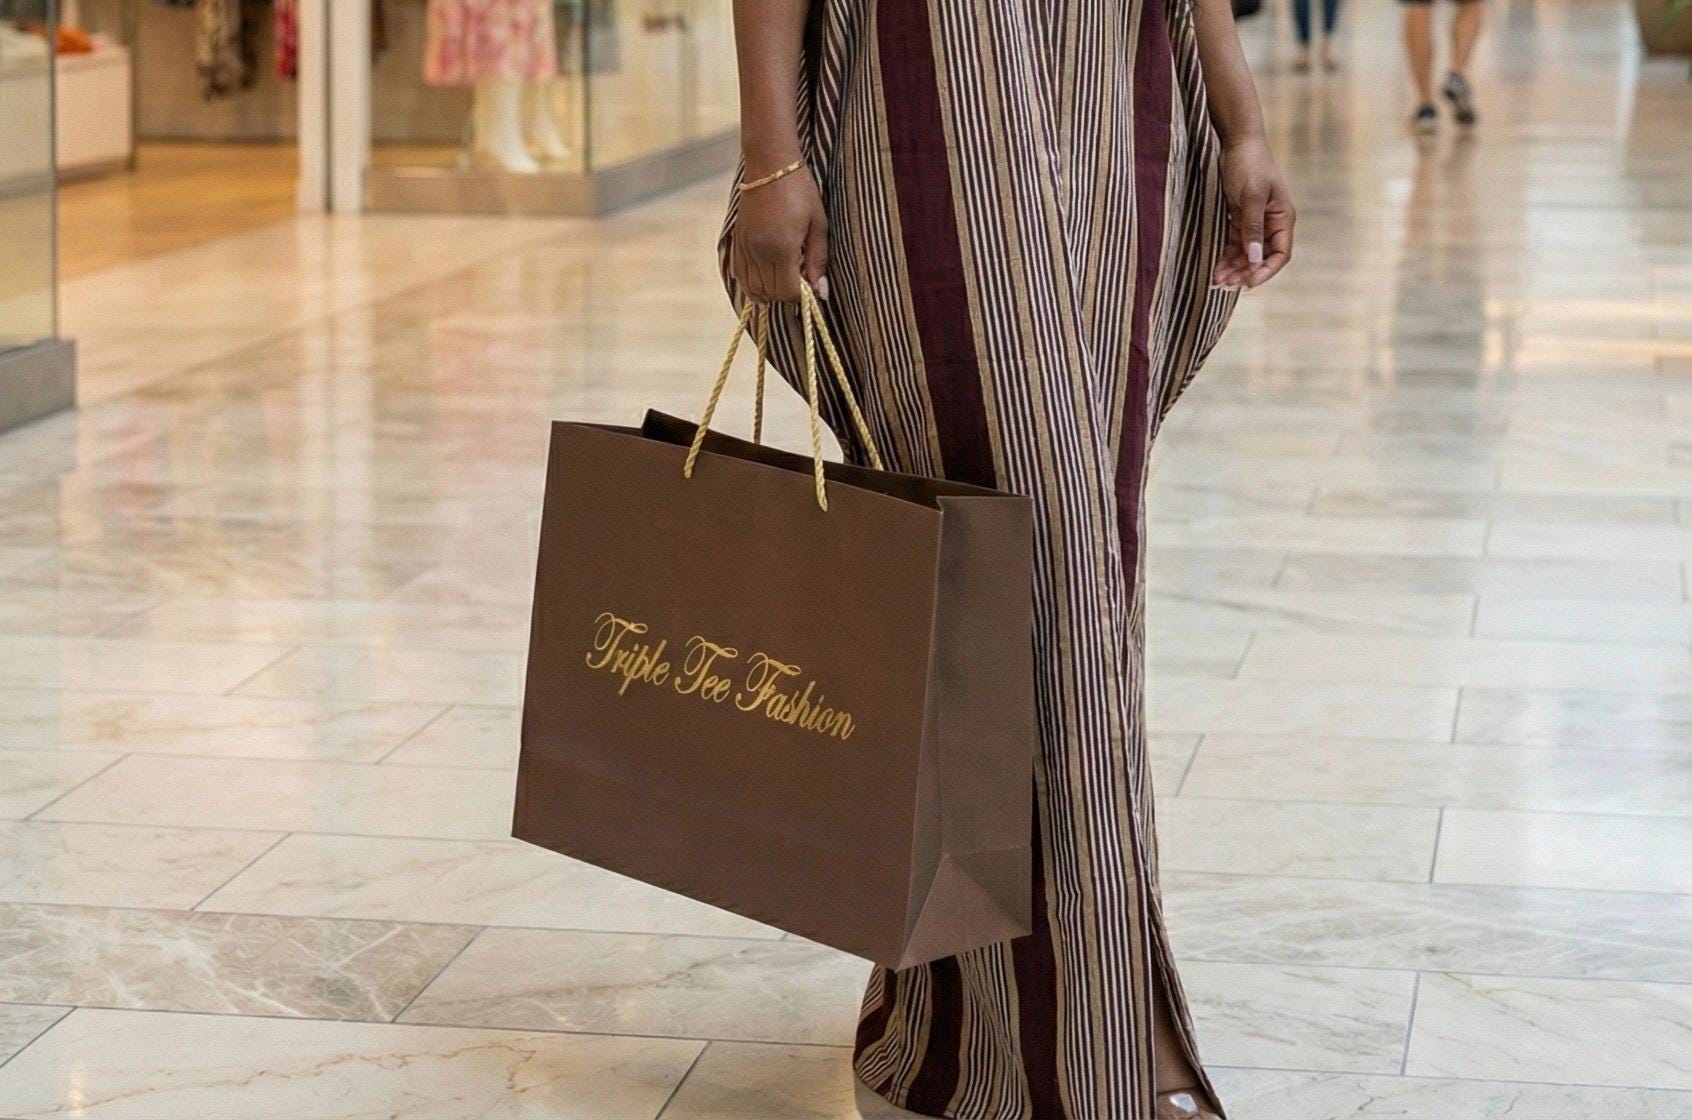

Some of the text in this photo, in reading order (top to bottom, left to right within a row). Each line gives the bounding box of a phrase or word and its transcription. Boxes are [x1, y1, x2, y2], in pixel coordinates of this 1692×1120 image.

[586, 612, 855, 740] Triple Tee Fashion
